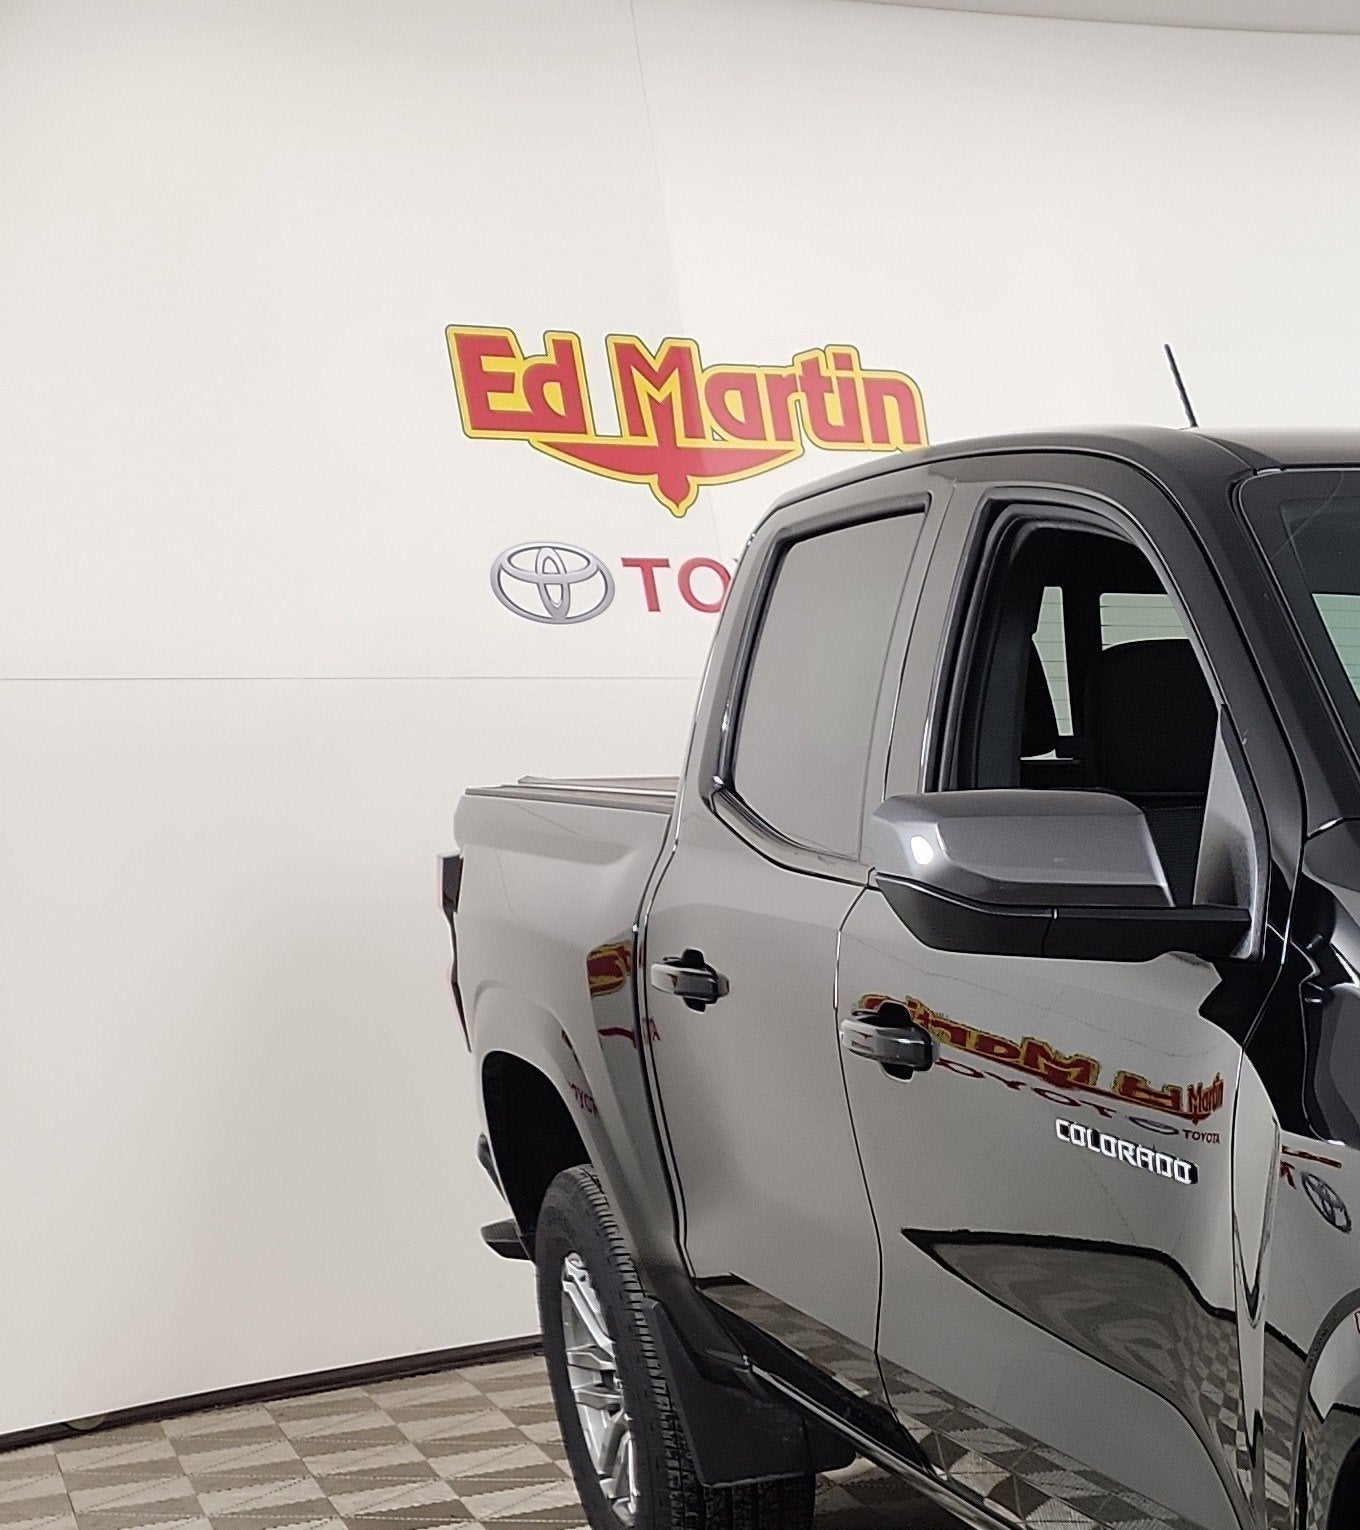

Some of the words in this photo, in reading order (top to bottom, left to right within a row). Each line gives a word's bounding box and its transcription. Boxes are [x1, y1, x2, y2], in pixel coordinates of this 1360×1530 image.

[445, 324, 595, 440] Ed
[605, 334, 929, 452] Martin
[1055, 1117, 1198, 1186] COLORADO
